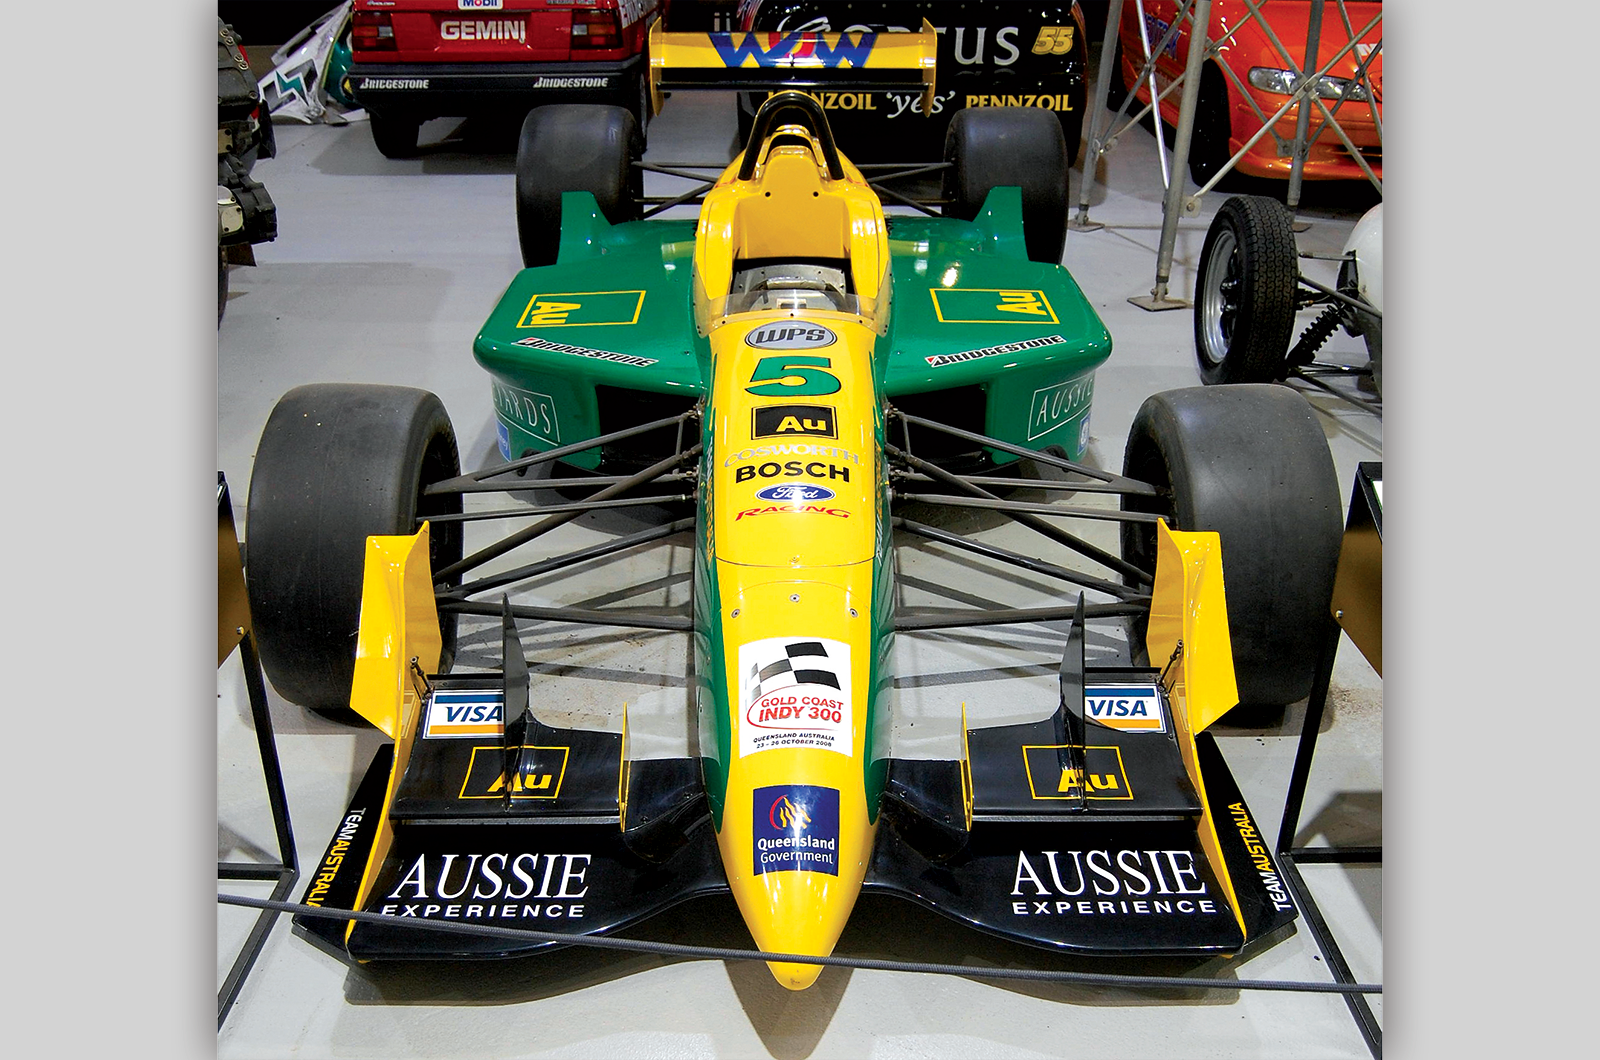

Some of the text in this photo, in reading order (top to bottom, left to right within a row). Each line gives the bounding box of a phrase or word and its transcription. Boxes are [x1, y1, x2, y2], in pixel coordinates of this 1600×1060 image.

[440, 20, 526, 41] GEMINI
[1032, 26, 1075, 55] 55
[533, 77, 609, 88] BRIDGESTONE
[768, 91, 877, 110] NZOIL
[965, 94, 1074, 112] PENNZOIL
[996, 291, 1048, 316] Au
[531, 301, 582, 326] Au
[755, 328, 826, 344] WPS
[519, 338, 656, 367] BRIDGESTONE
[932, 335, 1064, 367] BRIDGESTONE
[744, 356, 842, 397] 5
[776, 415, 827, 432] Au
[724, 444, 860, 468] COSWORTH
[735, 461, 850, 484] BOSCH
[772, 486, 819, 500] Ford
[735, 505, 852, 522] RACING
[761, 696, 844, 710] GOLD COAST
[1087, 699, 1148, 716] VISA
[446, 706, 503, 722] VISA
[758, 706, 842, 723] INDY 300
[753, 732, 835, 744] QUEENSLAND AUSTRALIA
[486, 770, 553, 793] Au
[1057, 768, 1120, 793] Au
[757, 835, 836, 851] Queensland
[760, 851, 834, 865] Government
[387, 853, 592, 900] AUSSIE
[1010, 850, 1206, 896] AUSSIE
[380, 904, 586, 918] EXPERIENCE
[1011, 900, 1218, 915] EXPERIENCE
